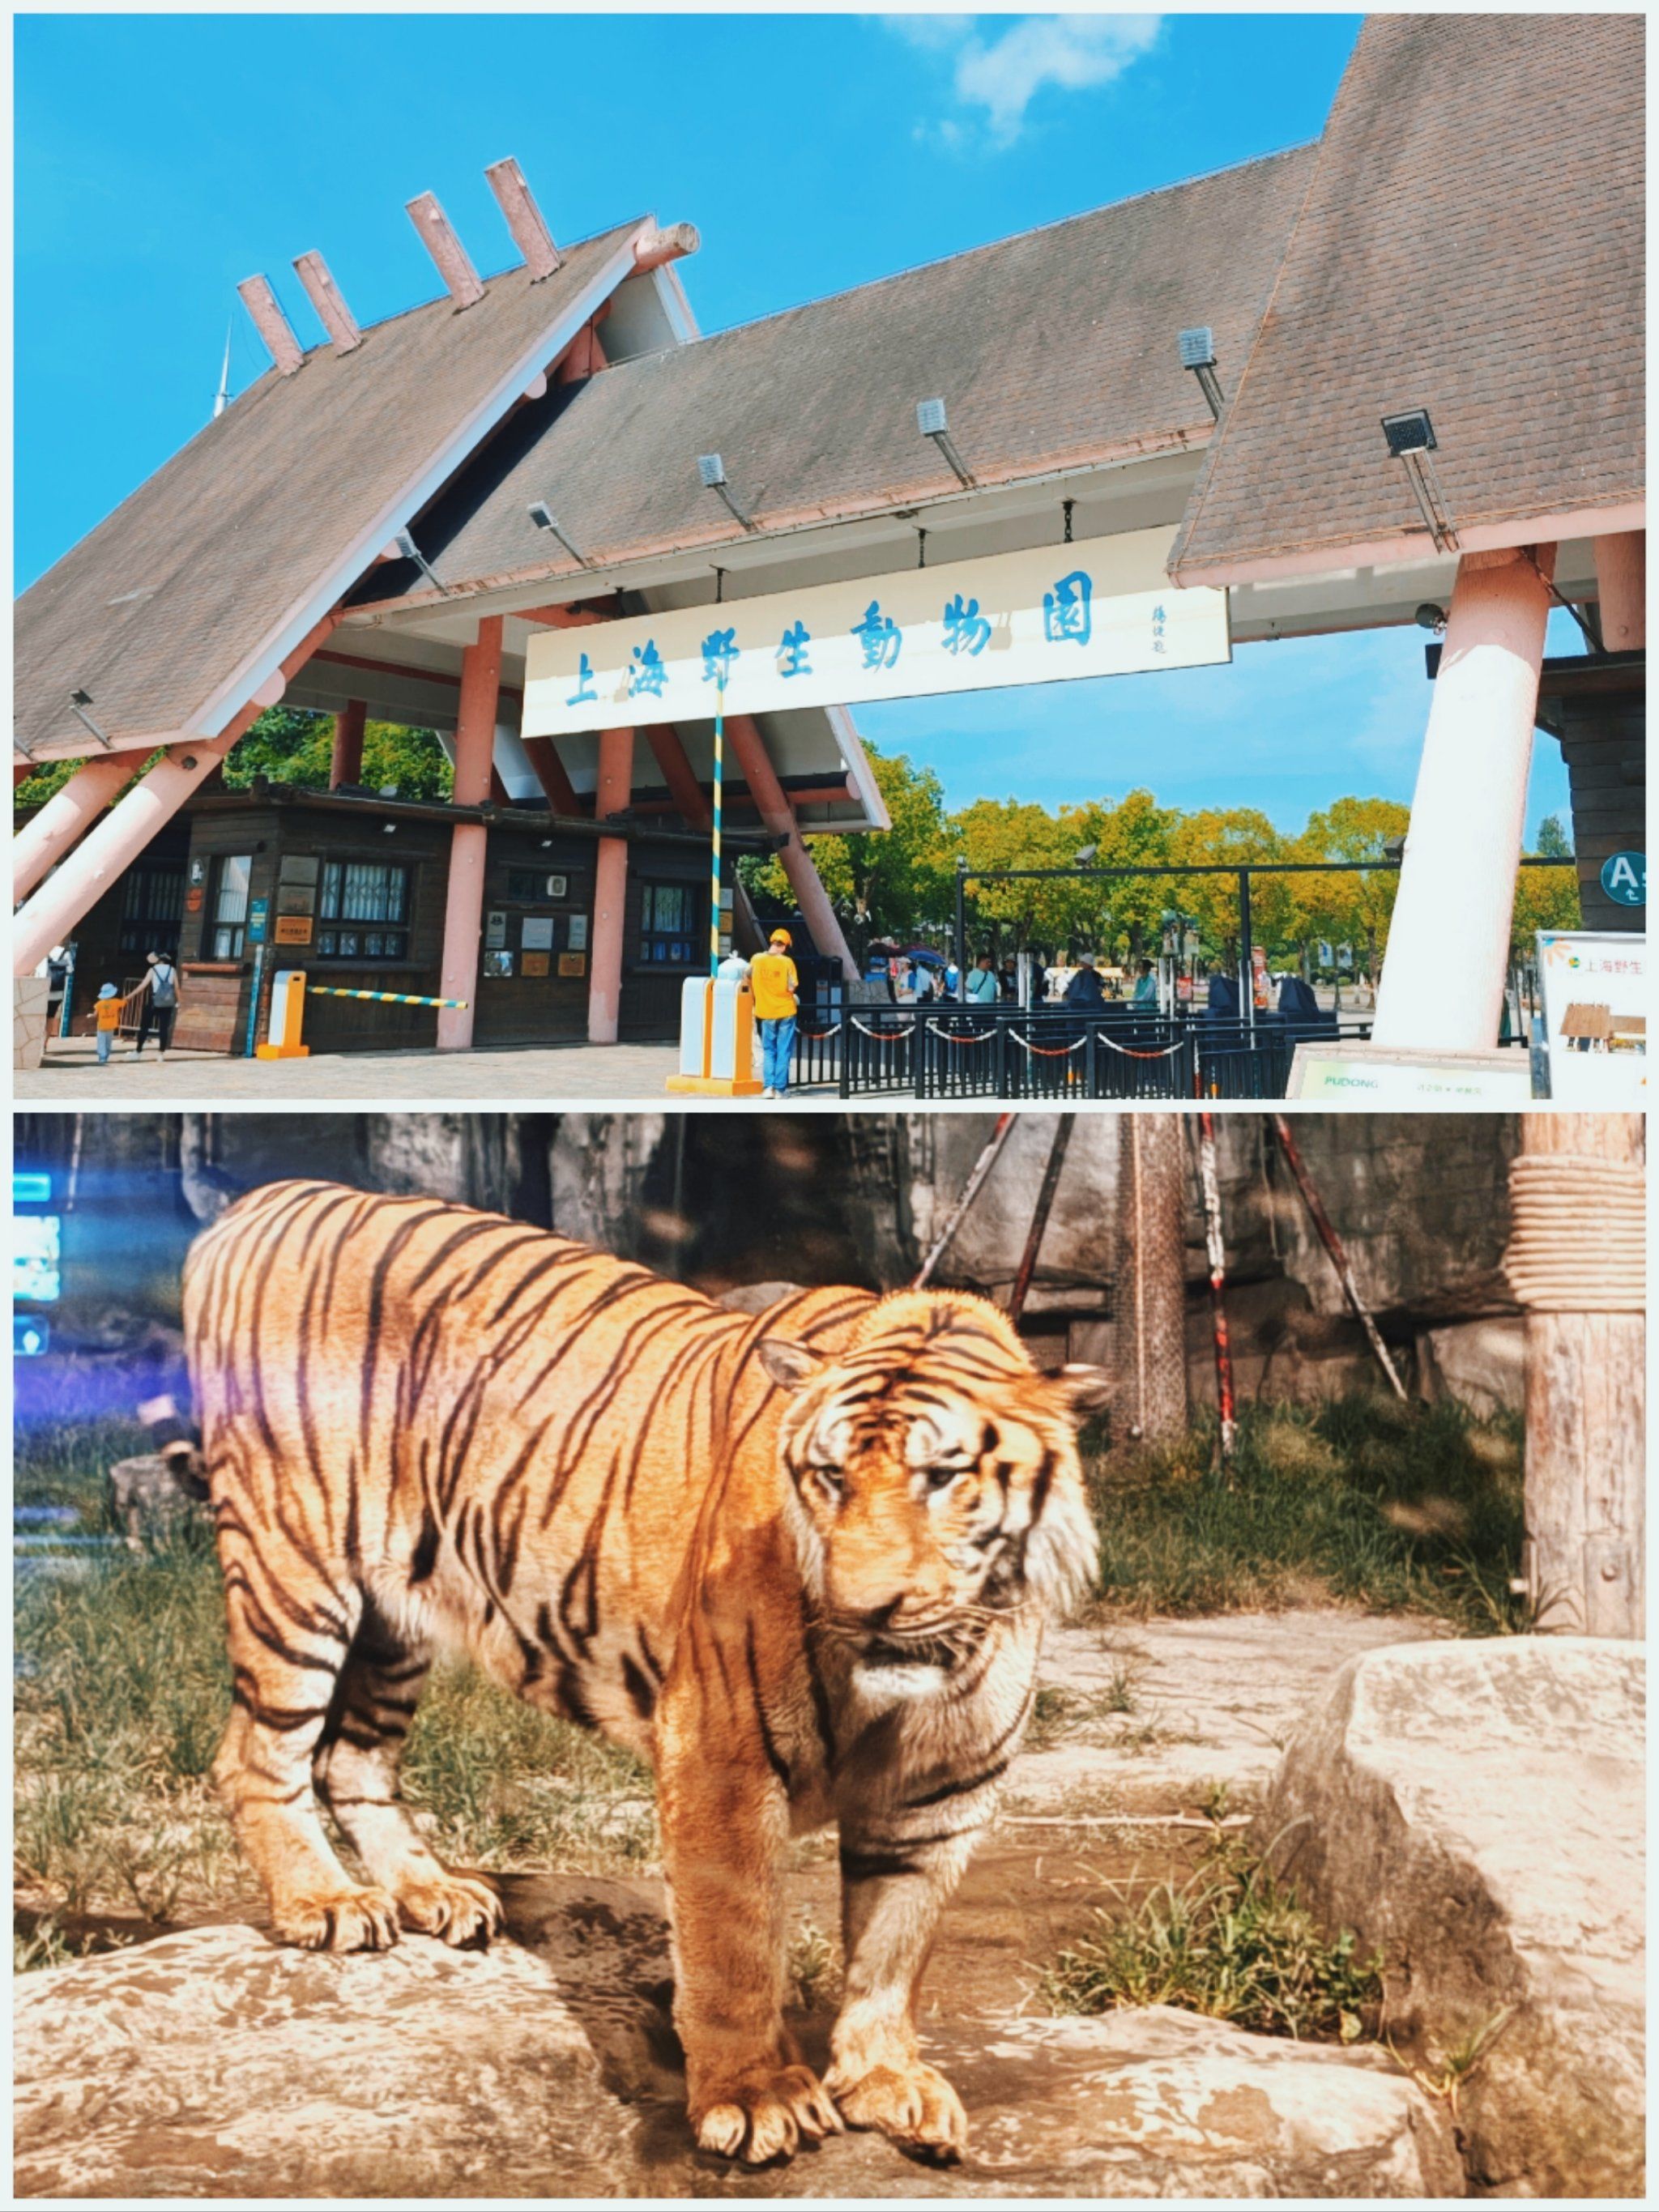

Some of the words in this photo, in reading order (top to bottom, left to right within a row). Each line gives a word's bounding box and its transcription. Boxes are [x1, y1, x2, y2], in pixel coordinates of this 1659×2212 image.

[565, 570, 1092, 706] 上海野生動物園
[1324, 1076, 1378, 1089] PUDONG
